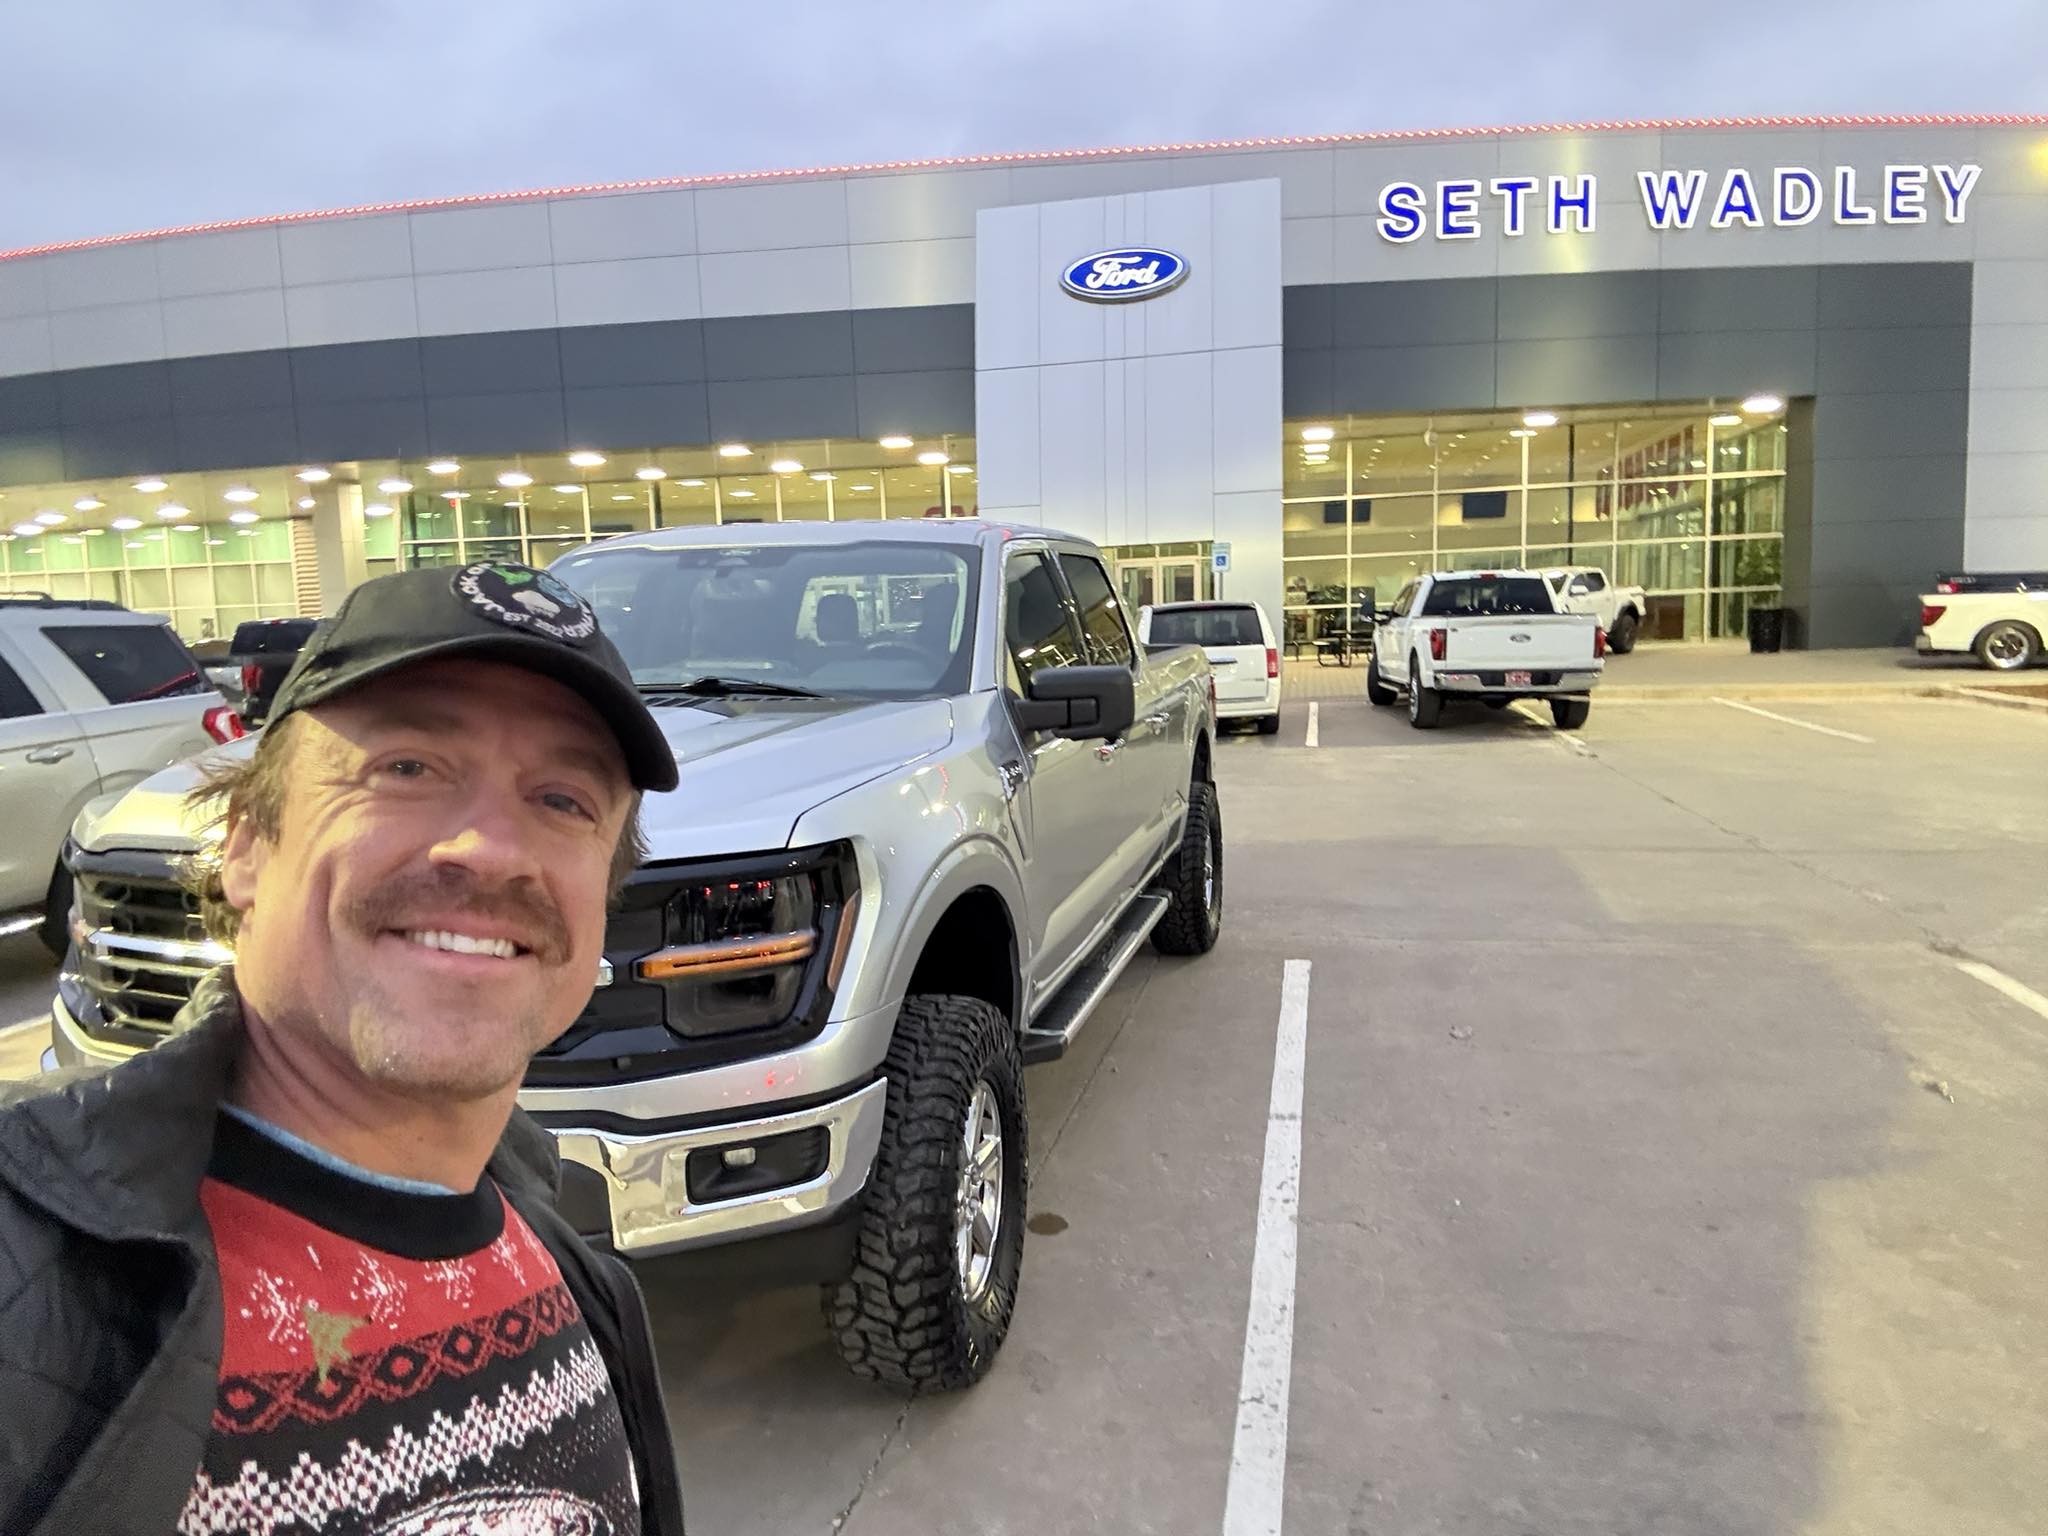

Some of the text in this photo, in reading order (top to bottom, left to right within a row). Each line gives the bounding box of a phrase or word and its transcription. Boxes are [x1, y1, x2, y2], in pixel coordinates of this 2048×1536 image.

[1375, 164, 1983, 244] SETH WADLEY
[1085, 256, 1160, 289] Ford
[503, 611, 532, 623] EST
